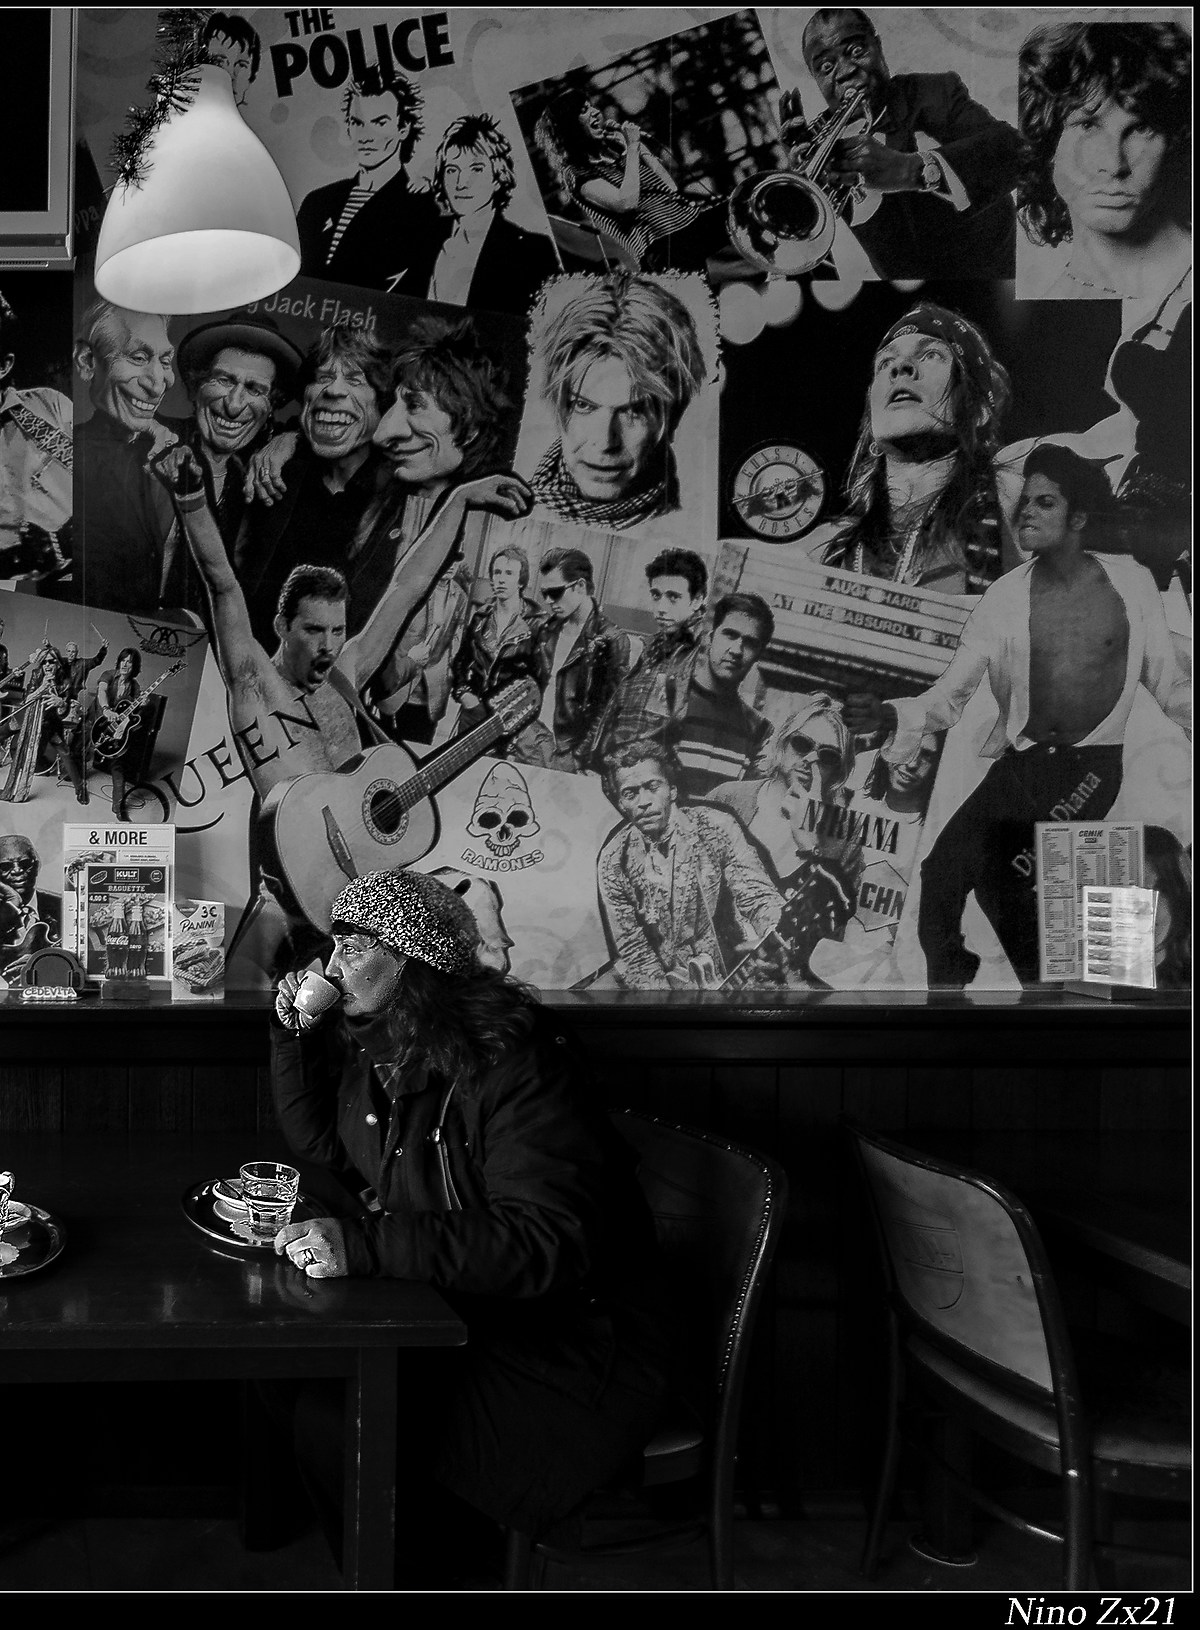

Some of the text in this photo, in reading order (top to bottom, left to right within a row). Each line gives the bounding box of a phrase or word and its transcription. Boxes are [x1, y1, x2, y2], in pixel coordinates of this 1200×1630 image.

[284, 8, 336, 38] THE
[269, 12, 456, 98] POLICE
[264, 292, 316, 319] Jack
[319, 298, 377, 332] Flash
[120, 692, 321, 834] QUEEN
[1049, 771, 1101, 821] Diana
[89, 830, 148, 846] & MORE
[798, 797, 900, 855] NIRVANA
[115, 870, 138, 878] KULT
[460, 846, 545, 872] RAMONES
[179, 919, 216, 933] PANINI
[24, 985, 76, 997] CEDEVITA
